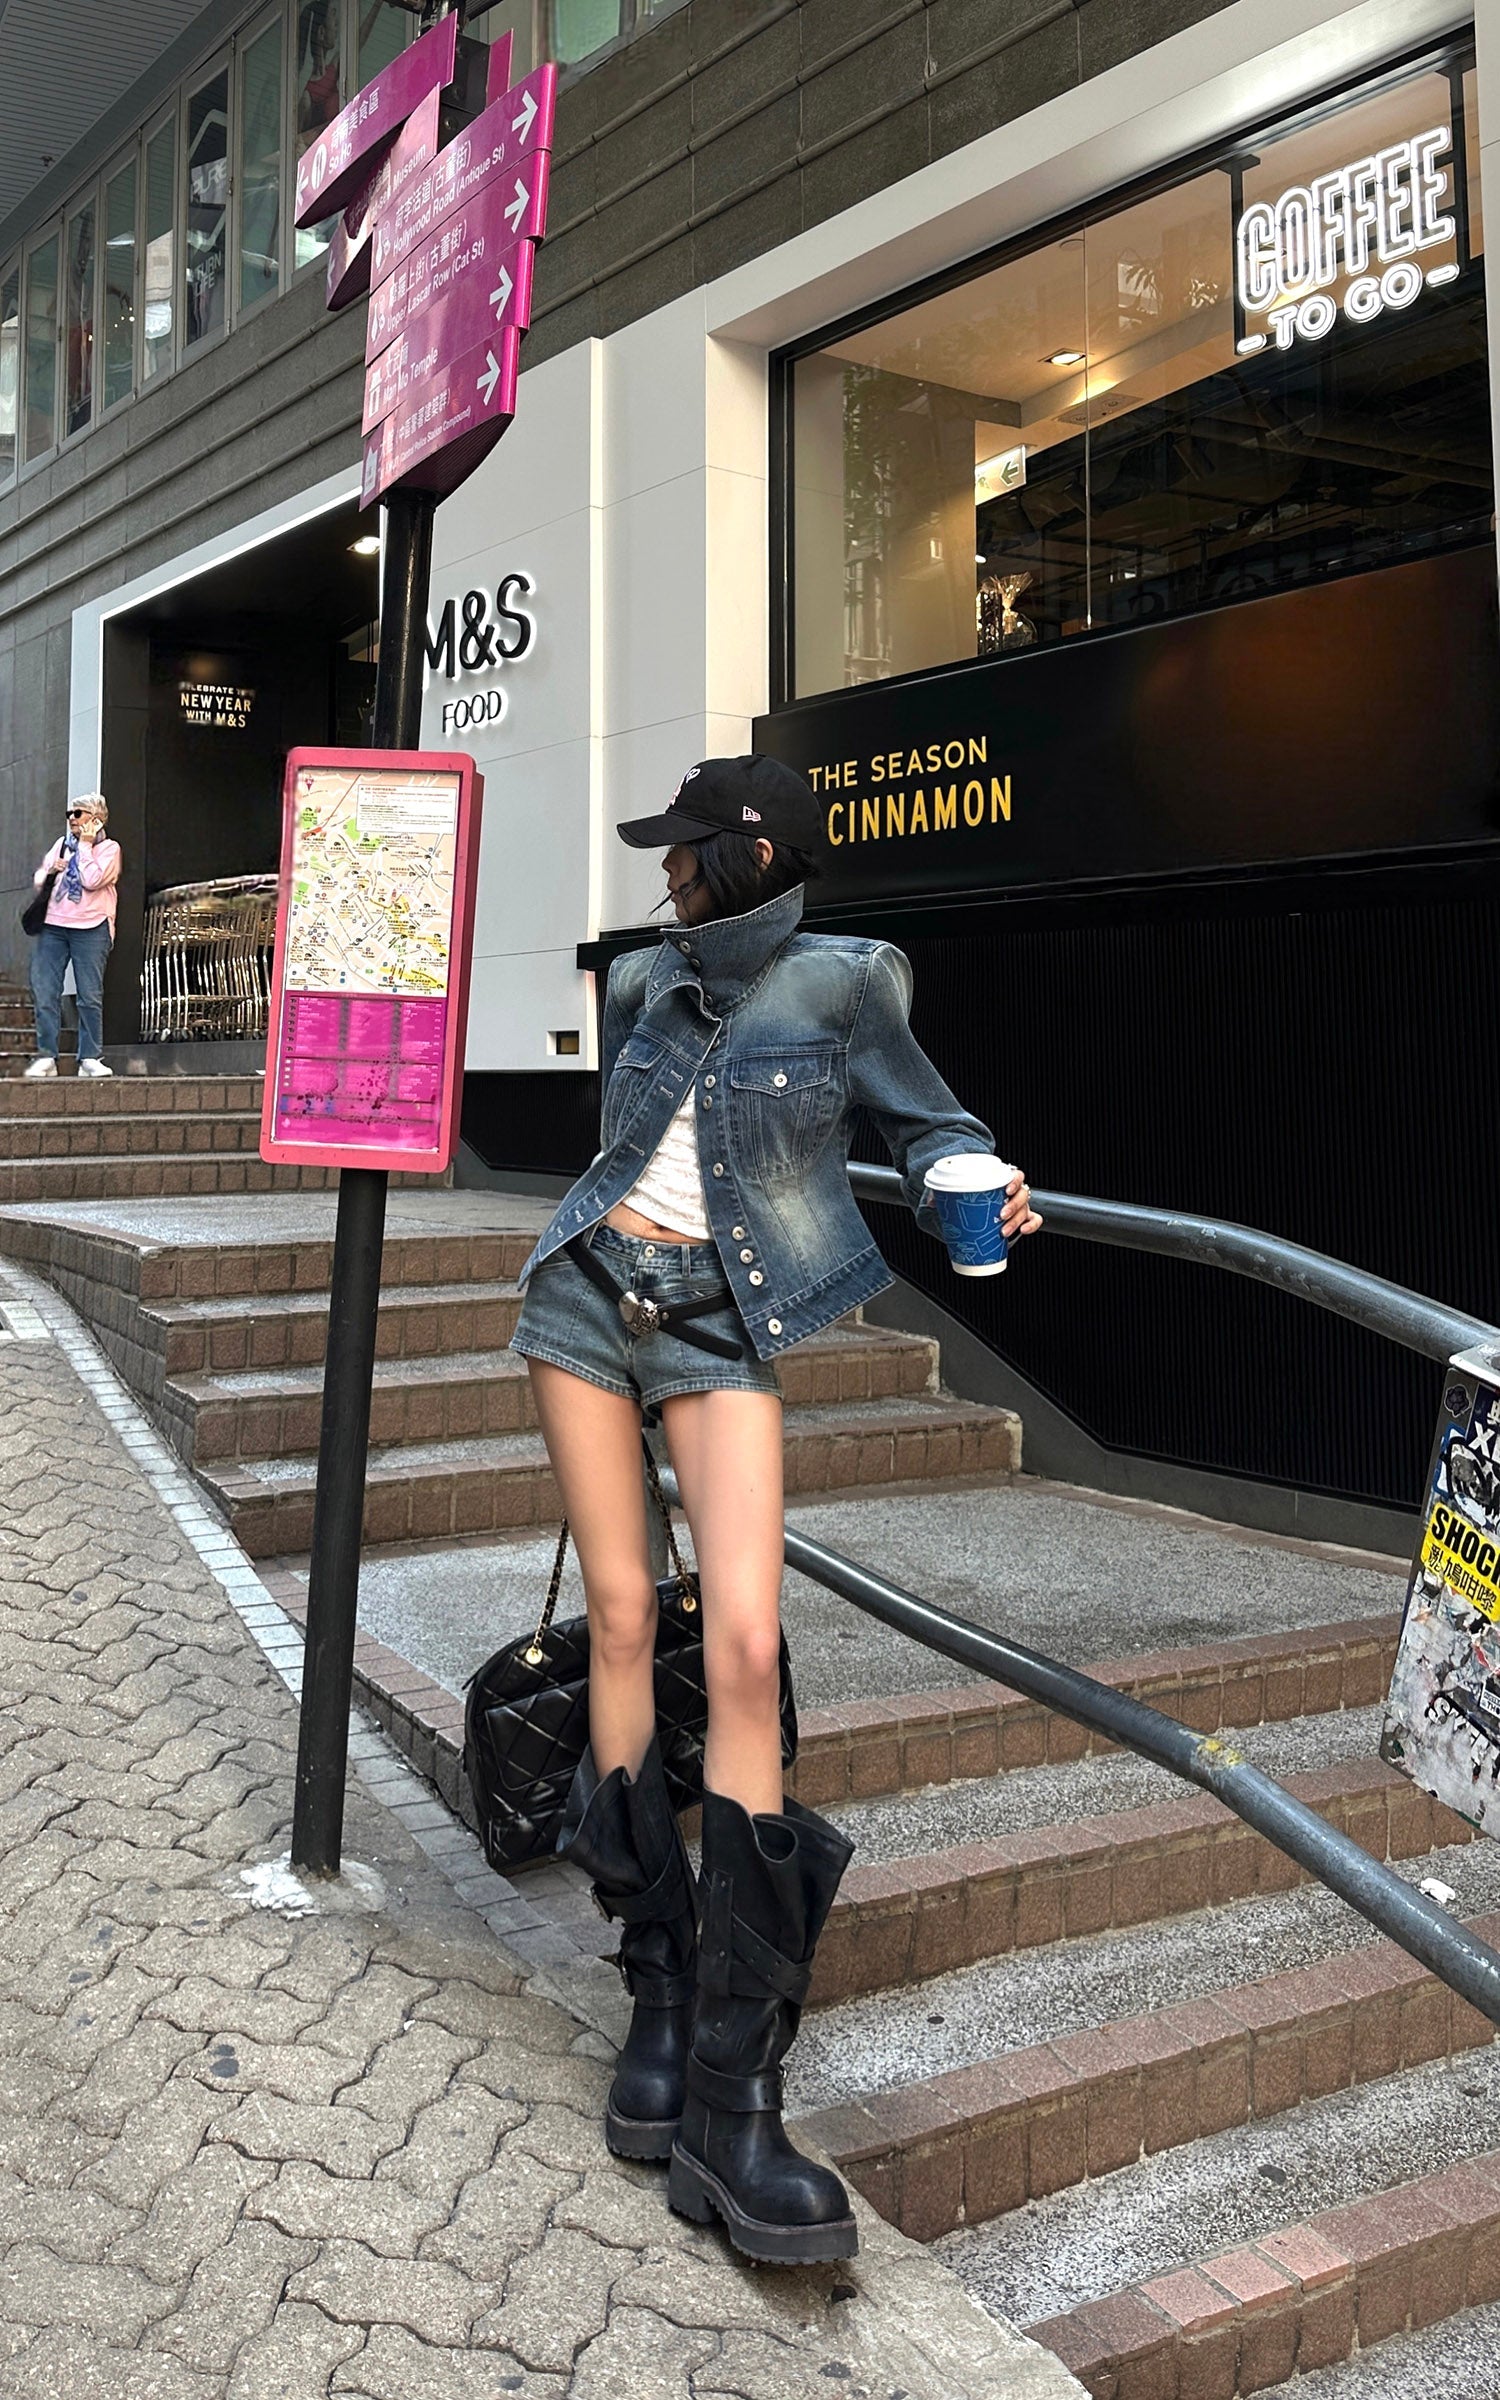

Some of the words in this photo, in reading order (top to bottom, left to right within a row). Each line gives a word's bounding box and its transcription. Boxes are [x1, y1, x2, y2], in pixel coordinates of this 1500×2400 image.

[392, 144, 426, 192] Museum
[393, 204, 431, 256] Hollywood
[433, 182, 456, 218] Road
[456, 158, 491, 197] (Antique
[492, 143, 505, 162] St)
[1237, 126, 1456, 311] COFFEE
[387, 304, 408, 333] Upper
[408, 283, 432, 314] Lascar
[432, 266, 451, 292] Row
[451, 248, 471, 280] (Cat
[471, 236, 485, 260] St)
[1268, 295, 1337, 350] TO
[1344, 262, 1423, 323] GO
[410, 347, 438, 382] Temple
[426, 573, 531, 679] M&S
[181, 693, 213, 709] NEW
[215, 696, 252, 713] YEAR
[186, 709, 212, 721] WITH
[215, 712, 246, 728] M&S
[442, 690, 502, 733] FOOD
[808, 760, 858, 792] THE
[871, 736, 987, 783] SEASON
[828, 775, 1012, 847] CINNAMON
